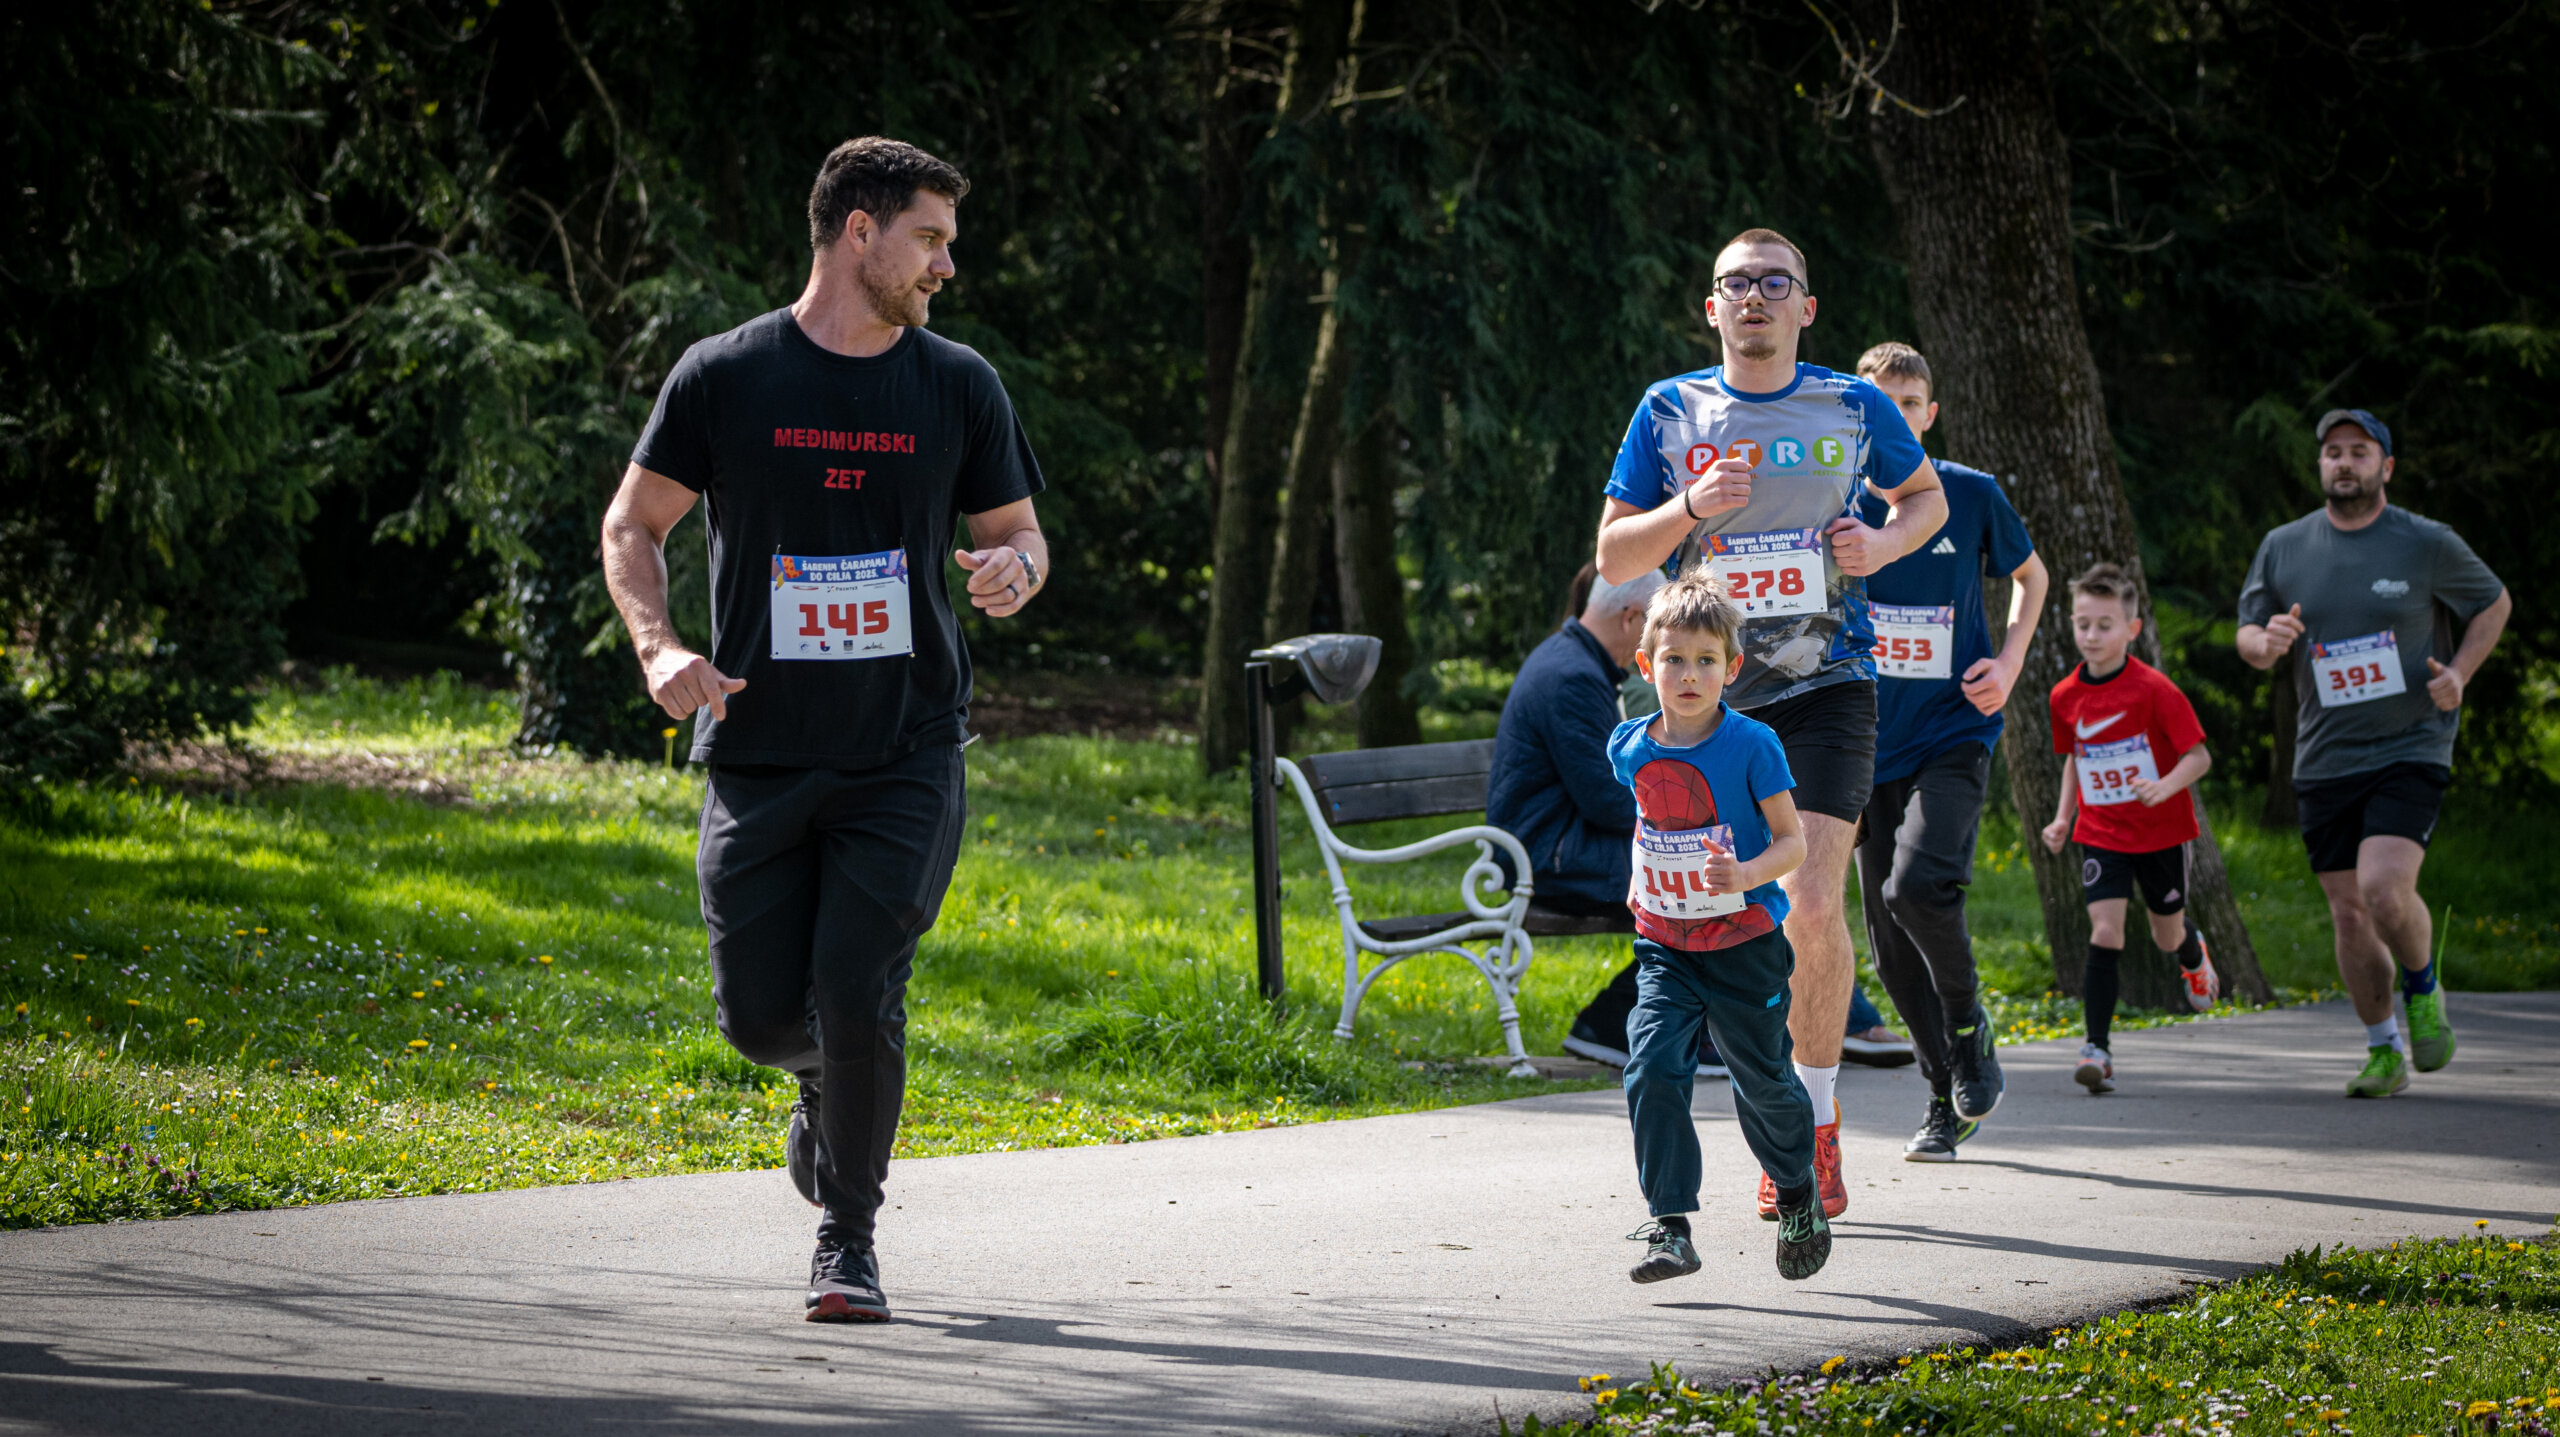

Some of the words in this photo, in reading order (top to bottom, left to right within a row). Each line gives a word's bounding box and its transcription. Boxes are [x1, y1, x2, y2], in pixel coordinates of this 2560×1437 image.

[774, 428, 915, 454] MEĐIMURSKI
[1776, 441, 1801, 464] R
[1822, 440, 1837, 463] F
[824, 468, 866, 490] ZET
[1734, 545, 1745, 554] DO
[1747, 543, 1768, 553] CILJA
[1771, 542, 1793, 551] 2025.
[810, 572, 822, 581] DO
[826, 571, 851, 581] CILJA
[855, 569, 879, 580] 2025.
[841, 557, 887, 570] ČARAPAMA
[1727, 567, 1805, 599] 278
[799, 600, 889, 636] 145
[1871, 634, 1933, 661] 553
[2328, 661, 2387, 691] 391
[2089, 765, 2140, 790] 392
